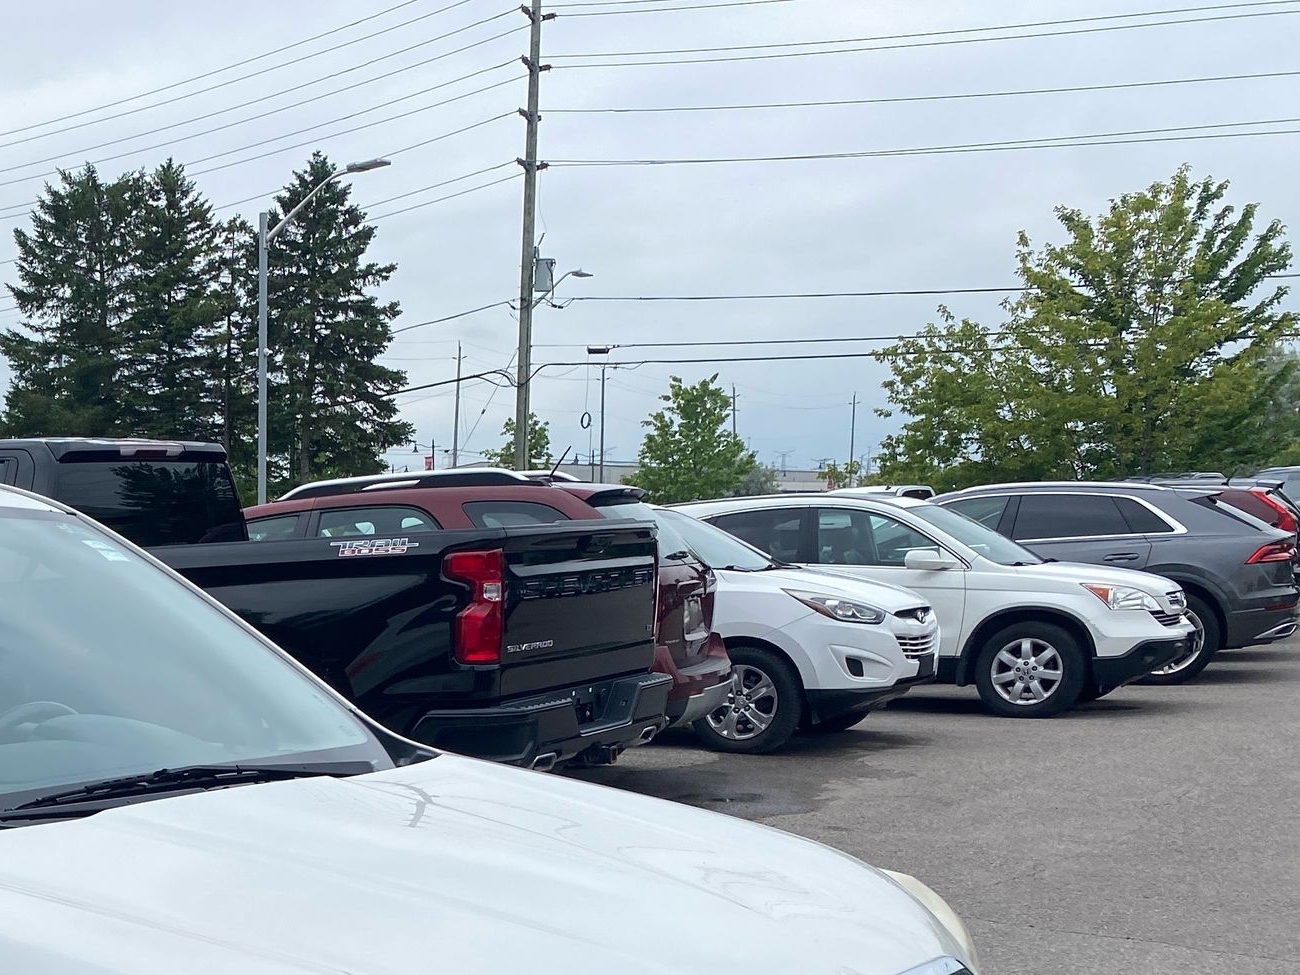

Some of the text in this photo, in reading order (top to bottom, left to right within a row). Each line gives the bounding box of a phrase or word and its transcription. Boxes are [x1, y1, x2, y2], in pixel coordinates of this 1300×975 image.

[329, 537, 419, 550] TRAIL
[338, 546, 408, 557] BOSS
[507, 639, 554, 653] SILVERADO
